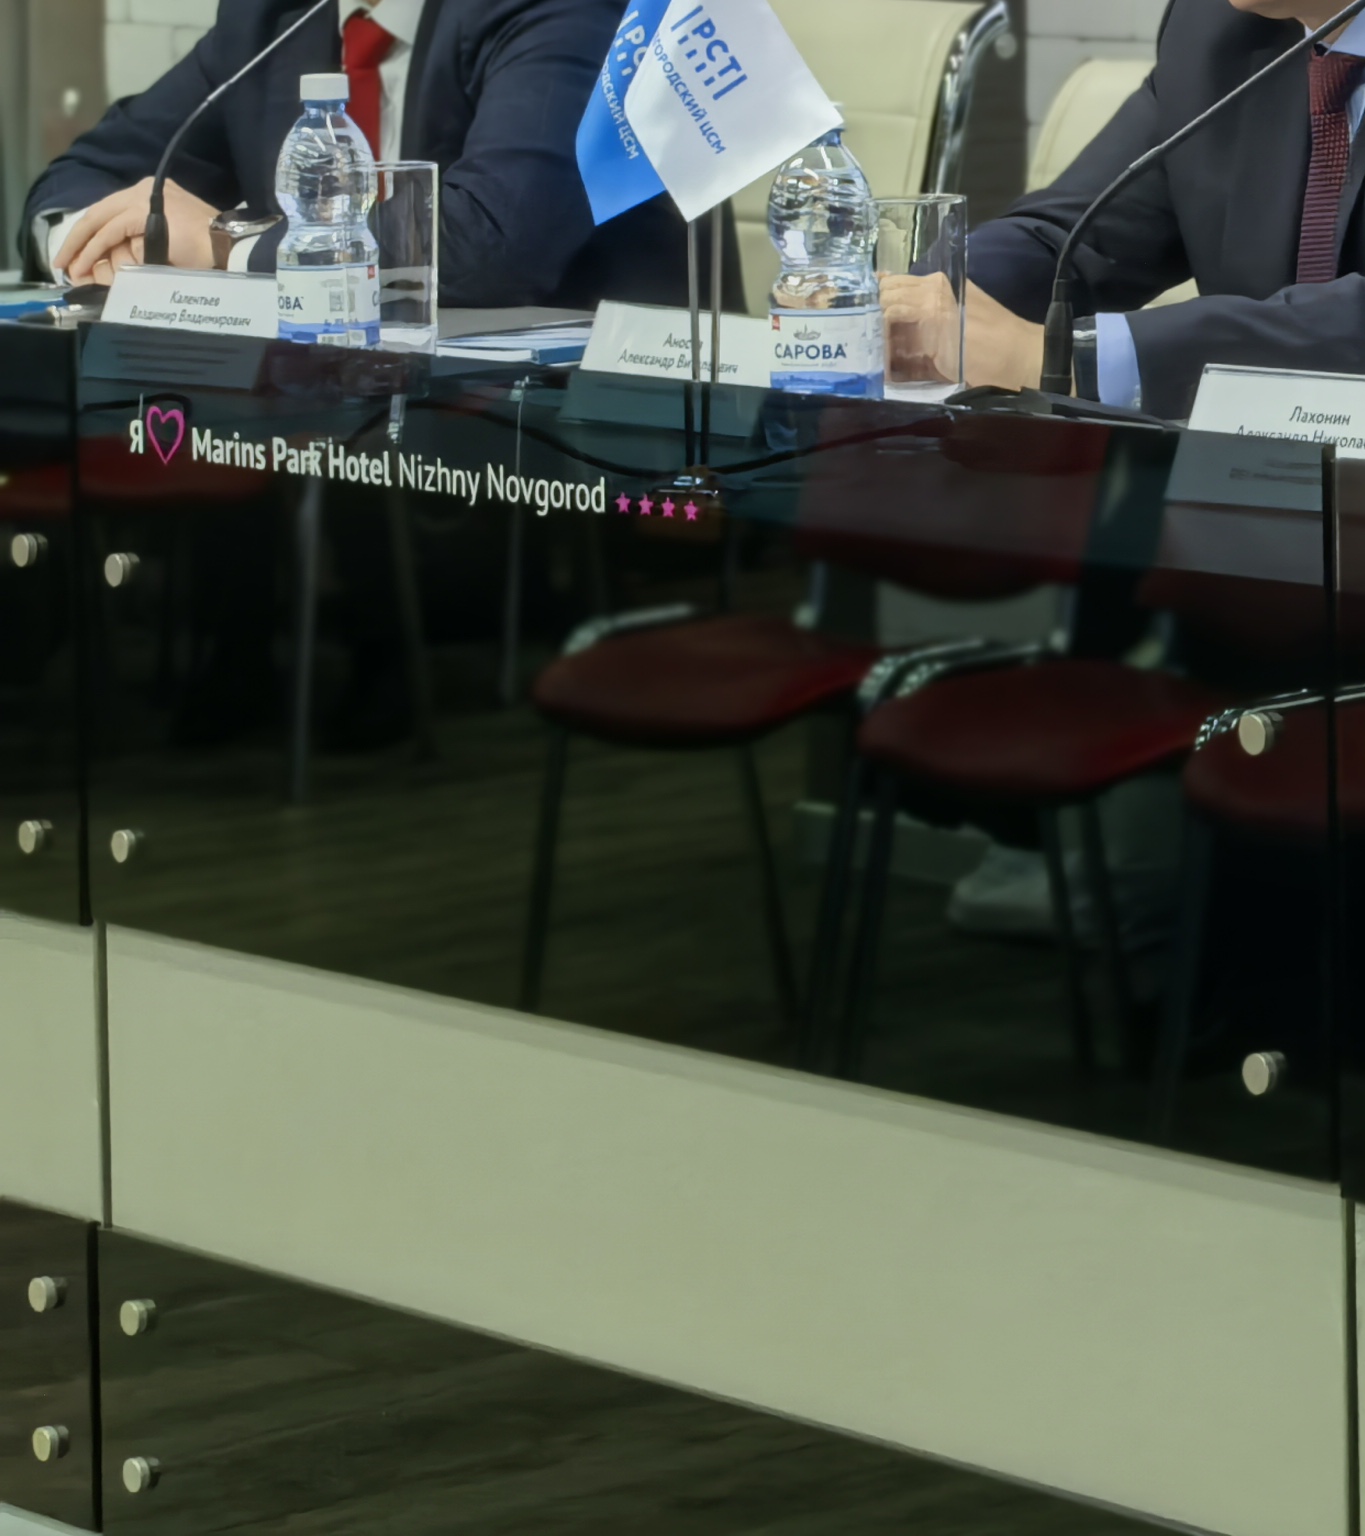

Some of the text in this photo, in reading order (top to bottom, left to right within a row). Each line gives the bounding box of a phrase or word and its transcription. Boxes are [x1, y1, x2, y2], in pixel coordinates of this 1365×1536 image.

[699, 120, 727, 155] ЦСМ
[774, 342, 847, 360] САРОВА
[1289, 405, 1352, 426] Лахонин
[129, 418, 606, 517] Я Marins Park Hotel Nizhny Novgorod
